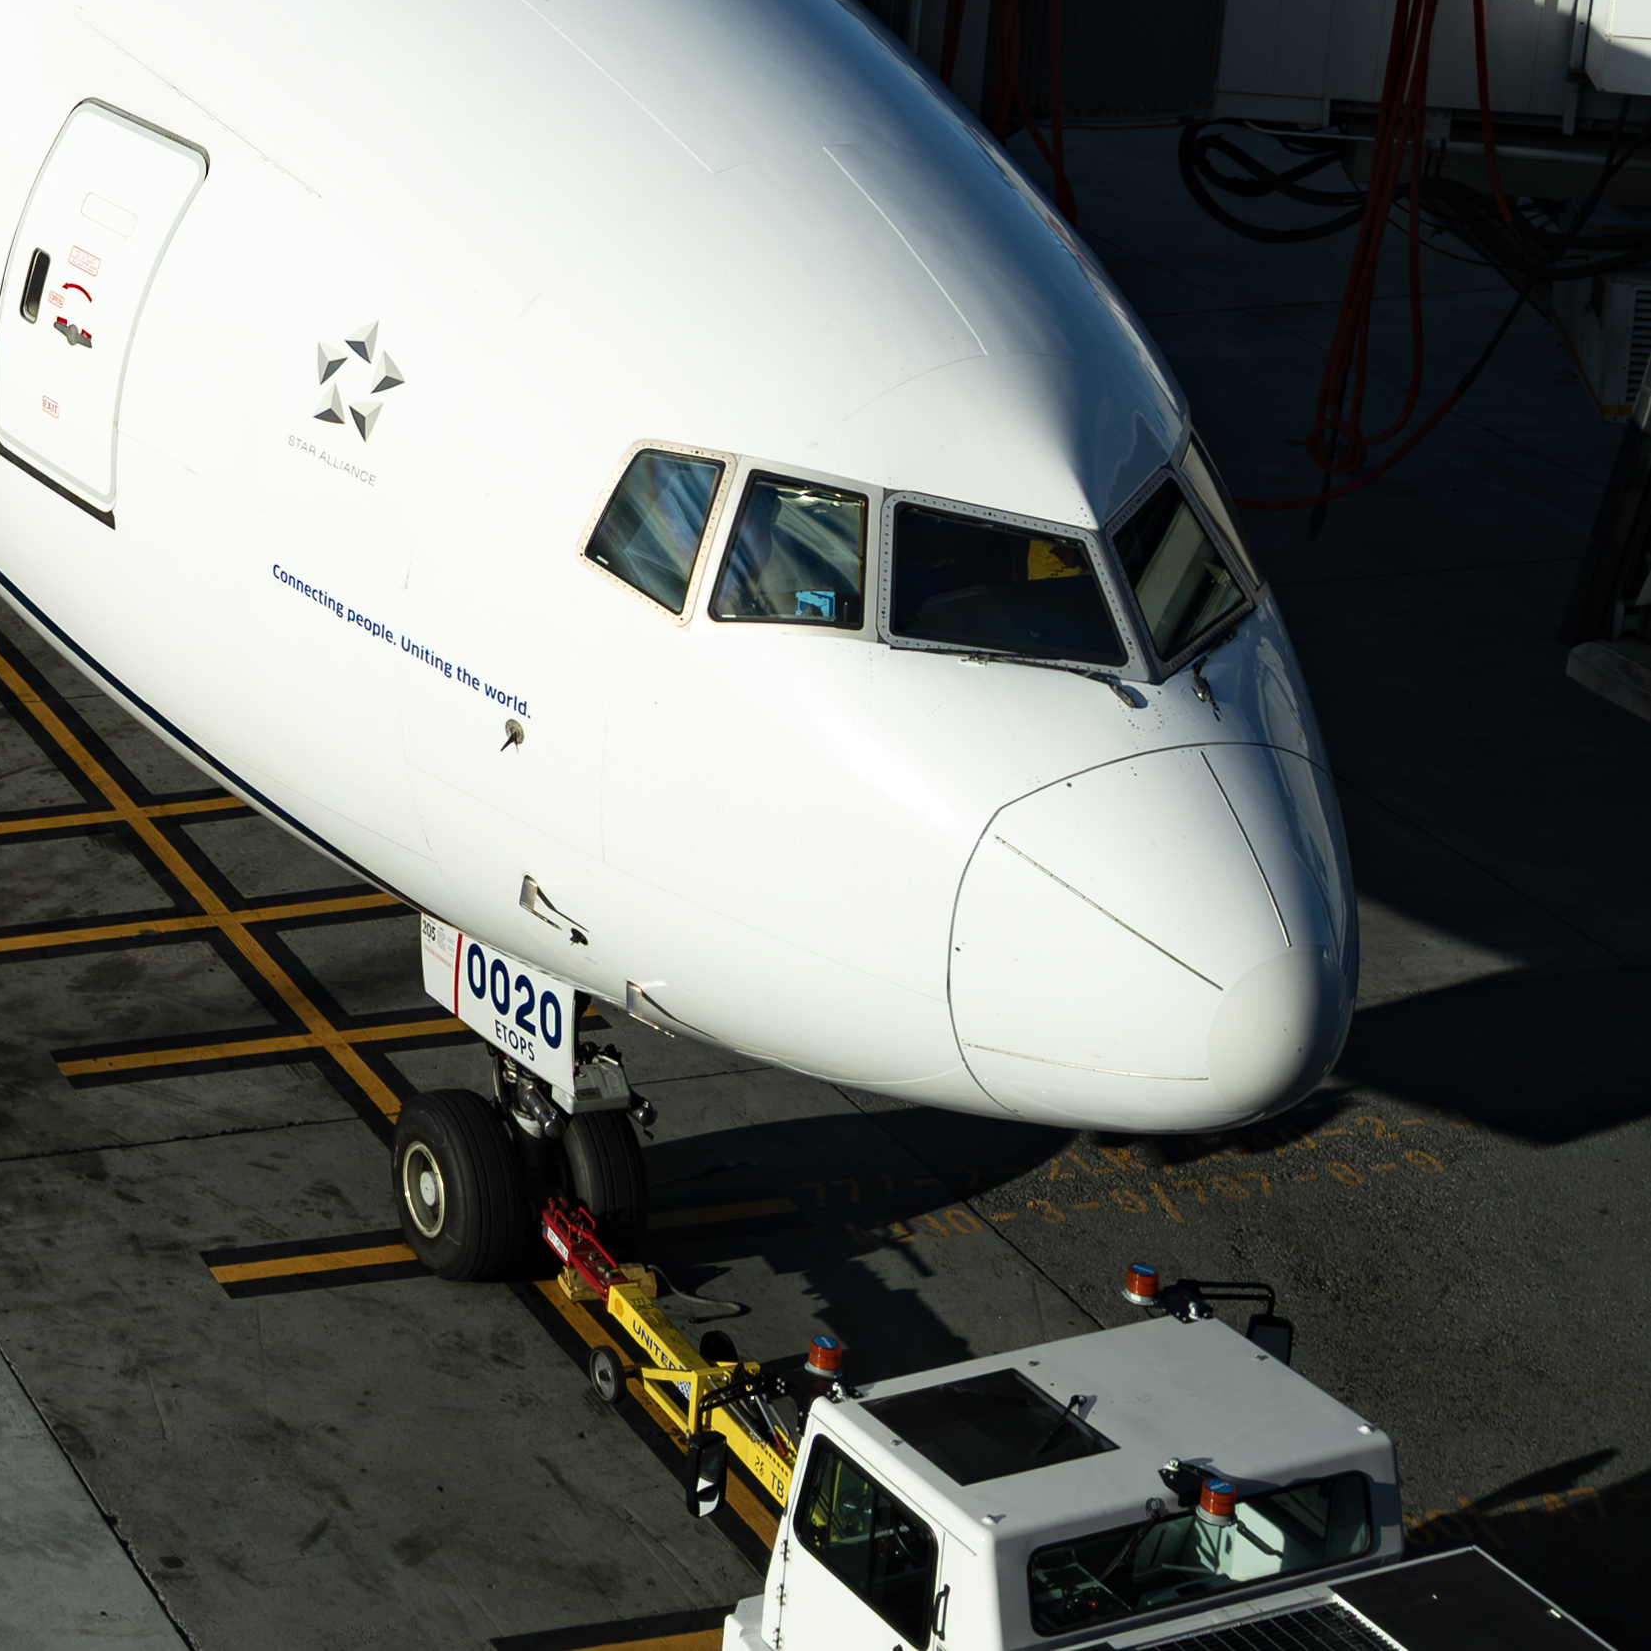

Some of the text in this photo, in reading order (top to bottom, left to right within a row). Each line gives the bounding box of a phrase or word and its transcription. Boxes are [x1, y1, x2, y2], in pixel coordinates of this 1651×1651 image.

[43, 399, 58, 416] EXIT
[287, 434, 377, 487] STAR ALLIANCE
[272, 564, 532, 719] Connecting people. Uniting the world.
[466, 942, 563, 1050] 0020
[494, 1019, 536, 1062] ETOPS
[770, 1471, 785, 1499] TB
